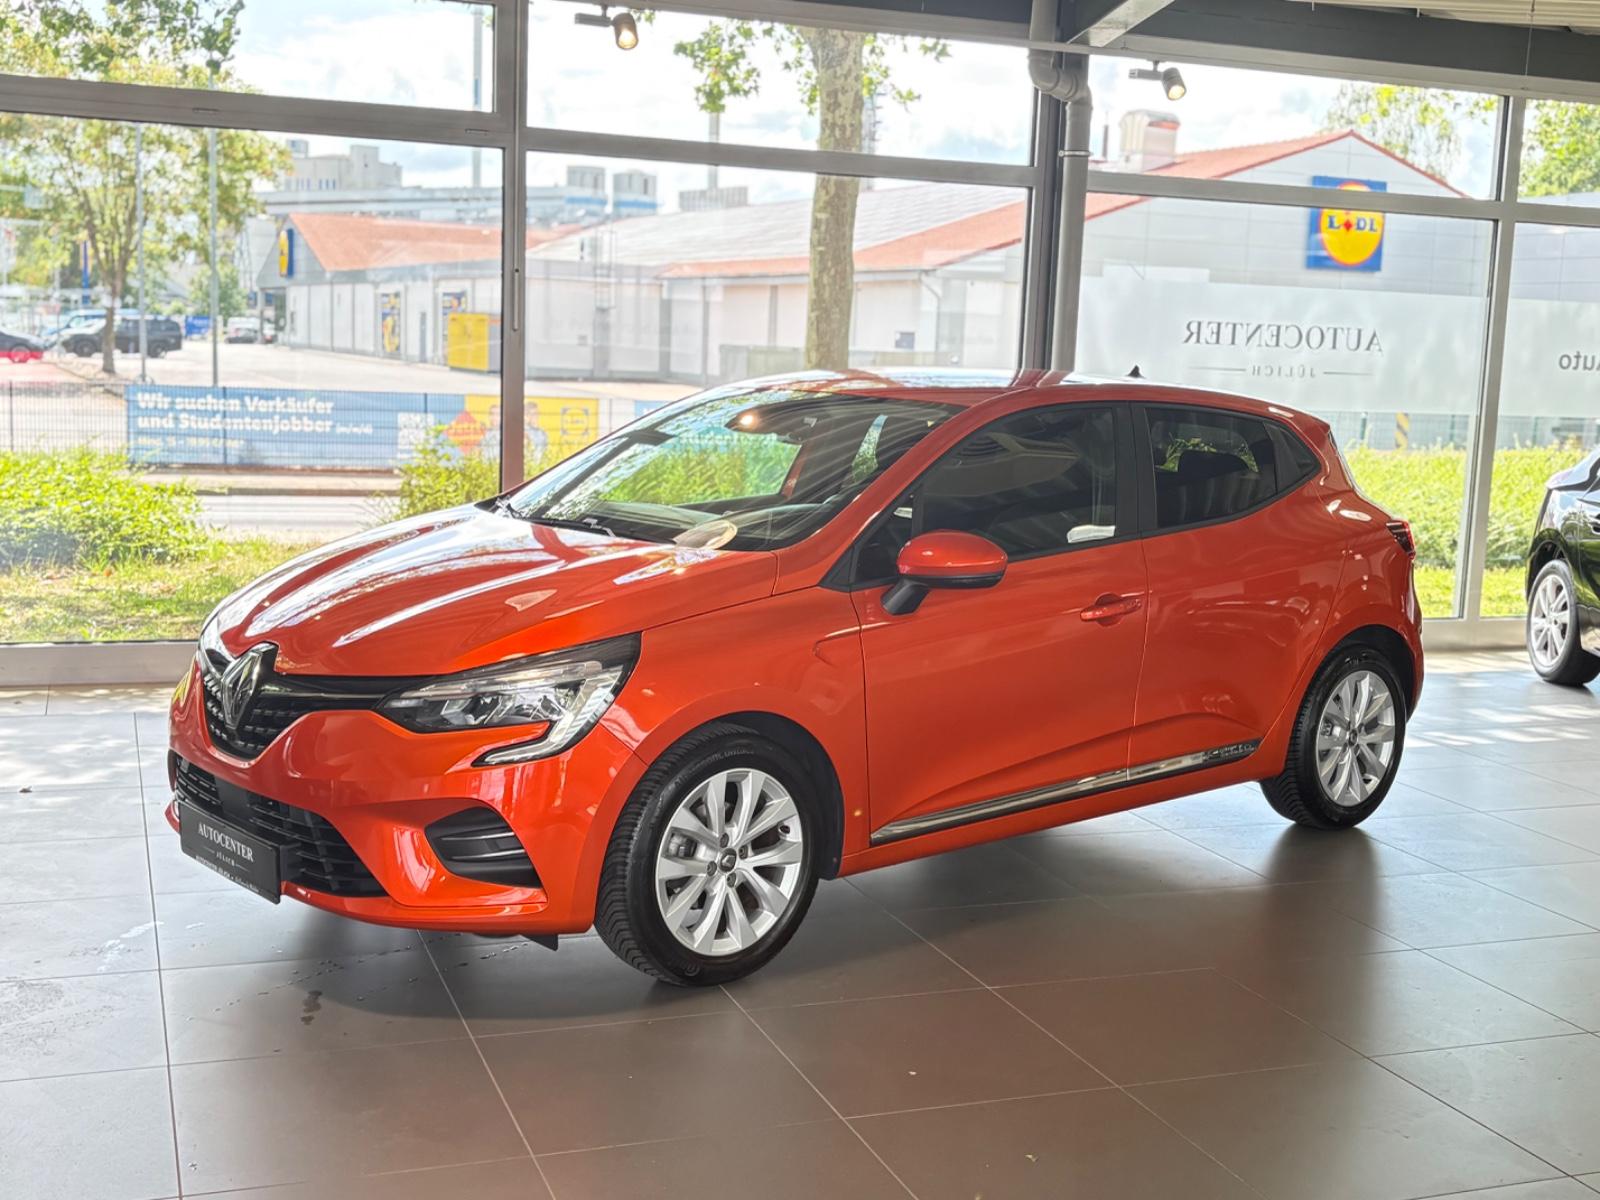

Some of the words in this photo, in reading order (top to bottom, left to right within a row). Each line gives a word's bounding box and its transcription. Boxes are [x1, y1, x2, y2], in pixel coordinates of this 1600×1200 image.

[136, 391, 172, 410] Wir
[174, 394, 241, 412] suchen
[243, 395, 336, 415] Verkäufer
[137, 412, 174, 429] und
[177, 413, 334, 436] Studentenjobber
[198, 822, 254, 862] AUTOCENTER
